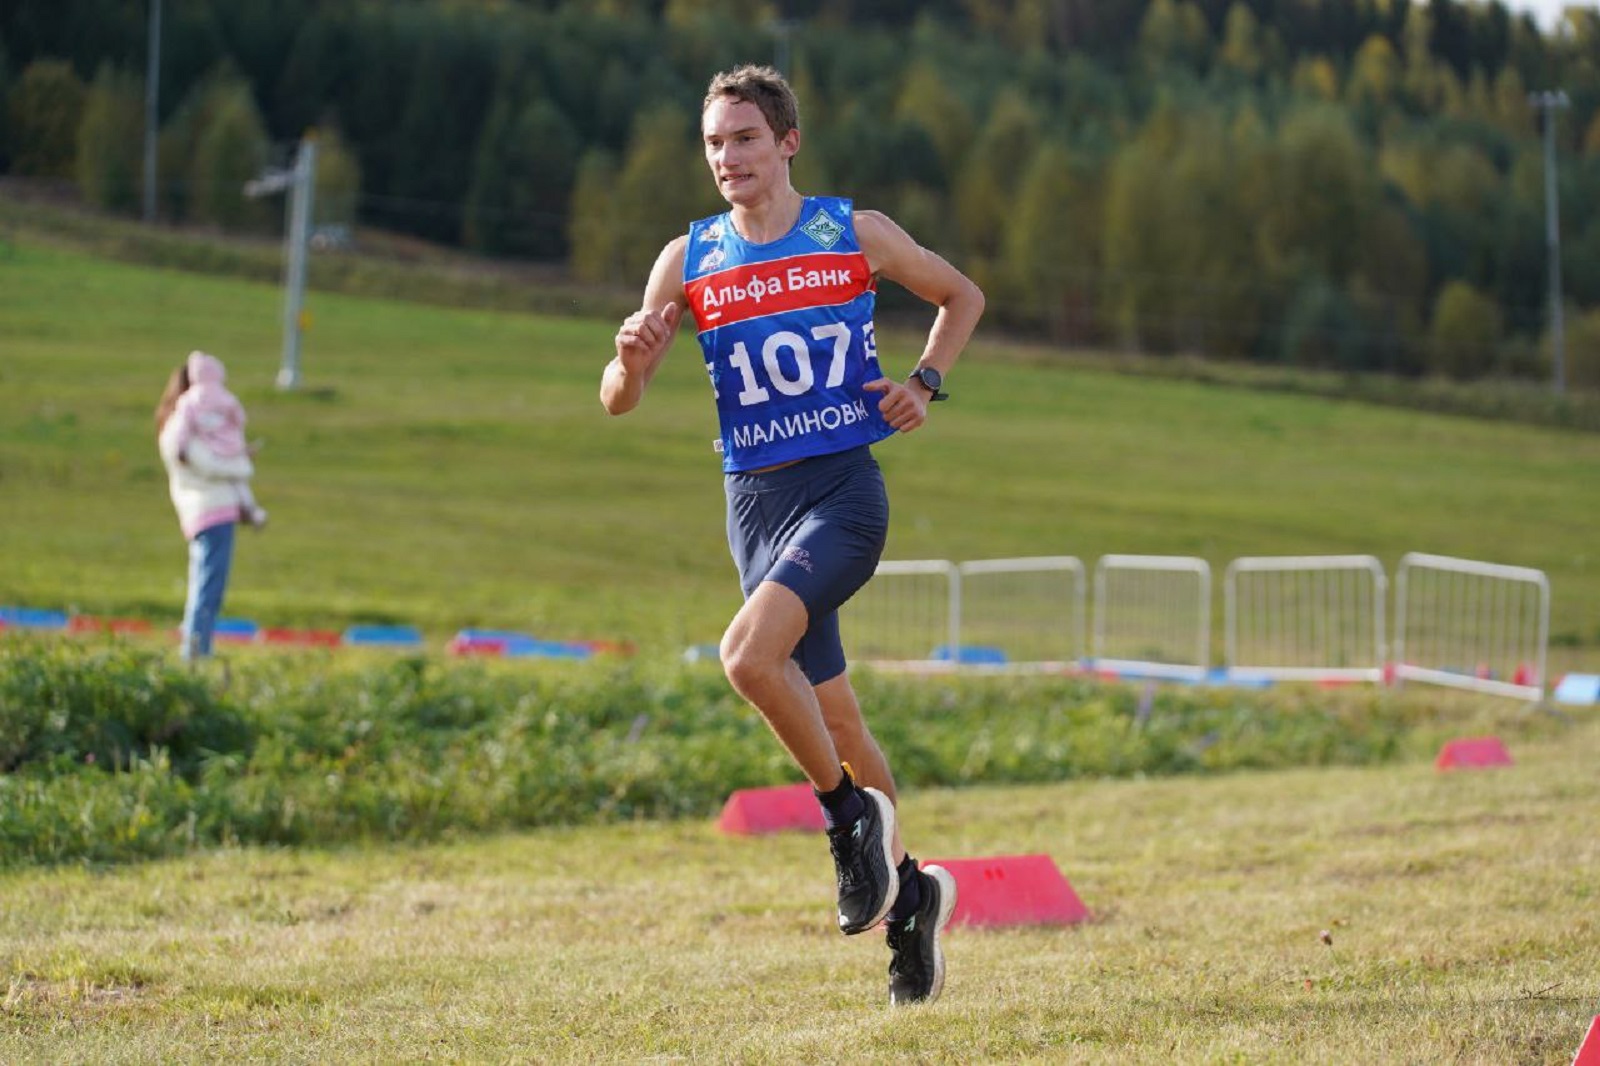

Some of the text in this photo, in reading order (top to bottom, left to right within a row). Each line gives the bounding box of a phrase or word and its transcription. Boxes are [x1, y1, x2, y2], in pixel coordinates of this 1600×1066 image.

[703, 266, 852, 311] Альфа Банк
[728, 321, 851, 406] 107
